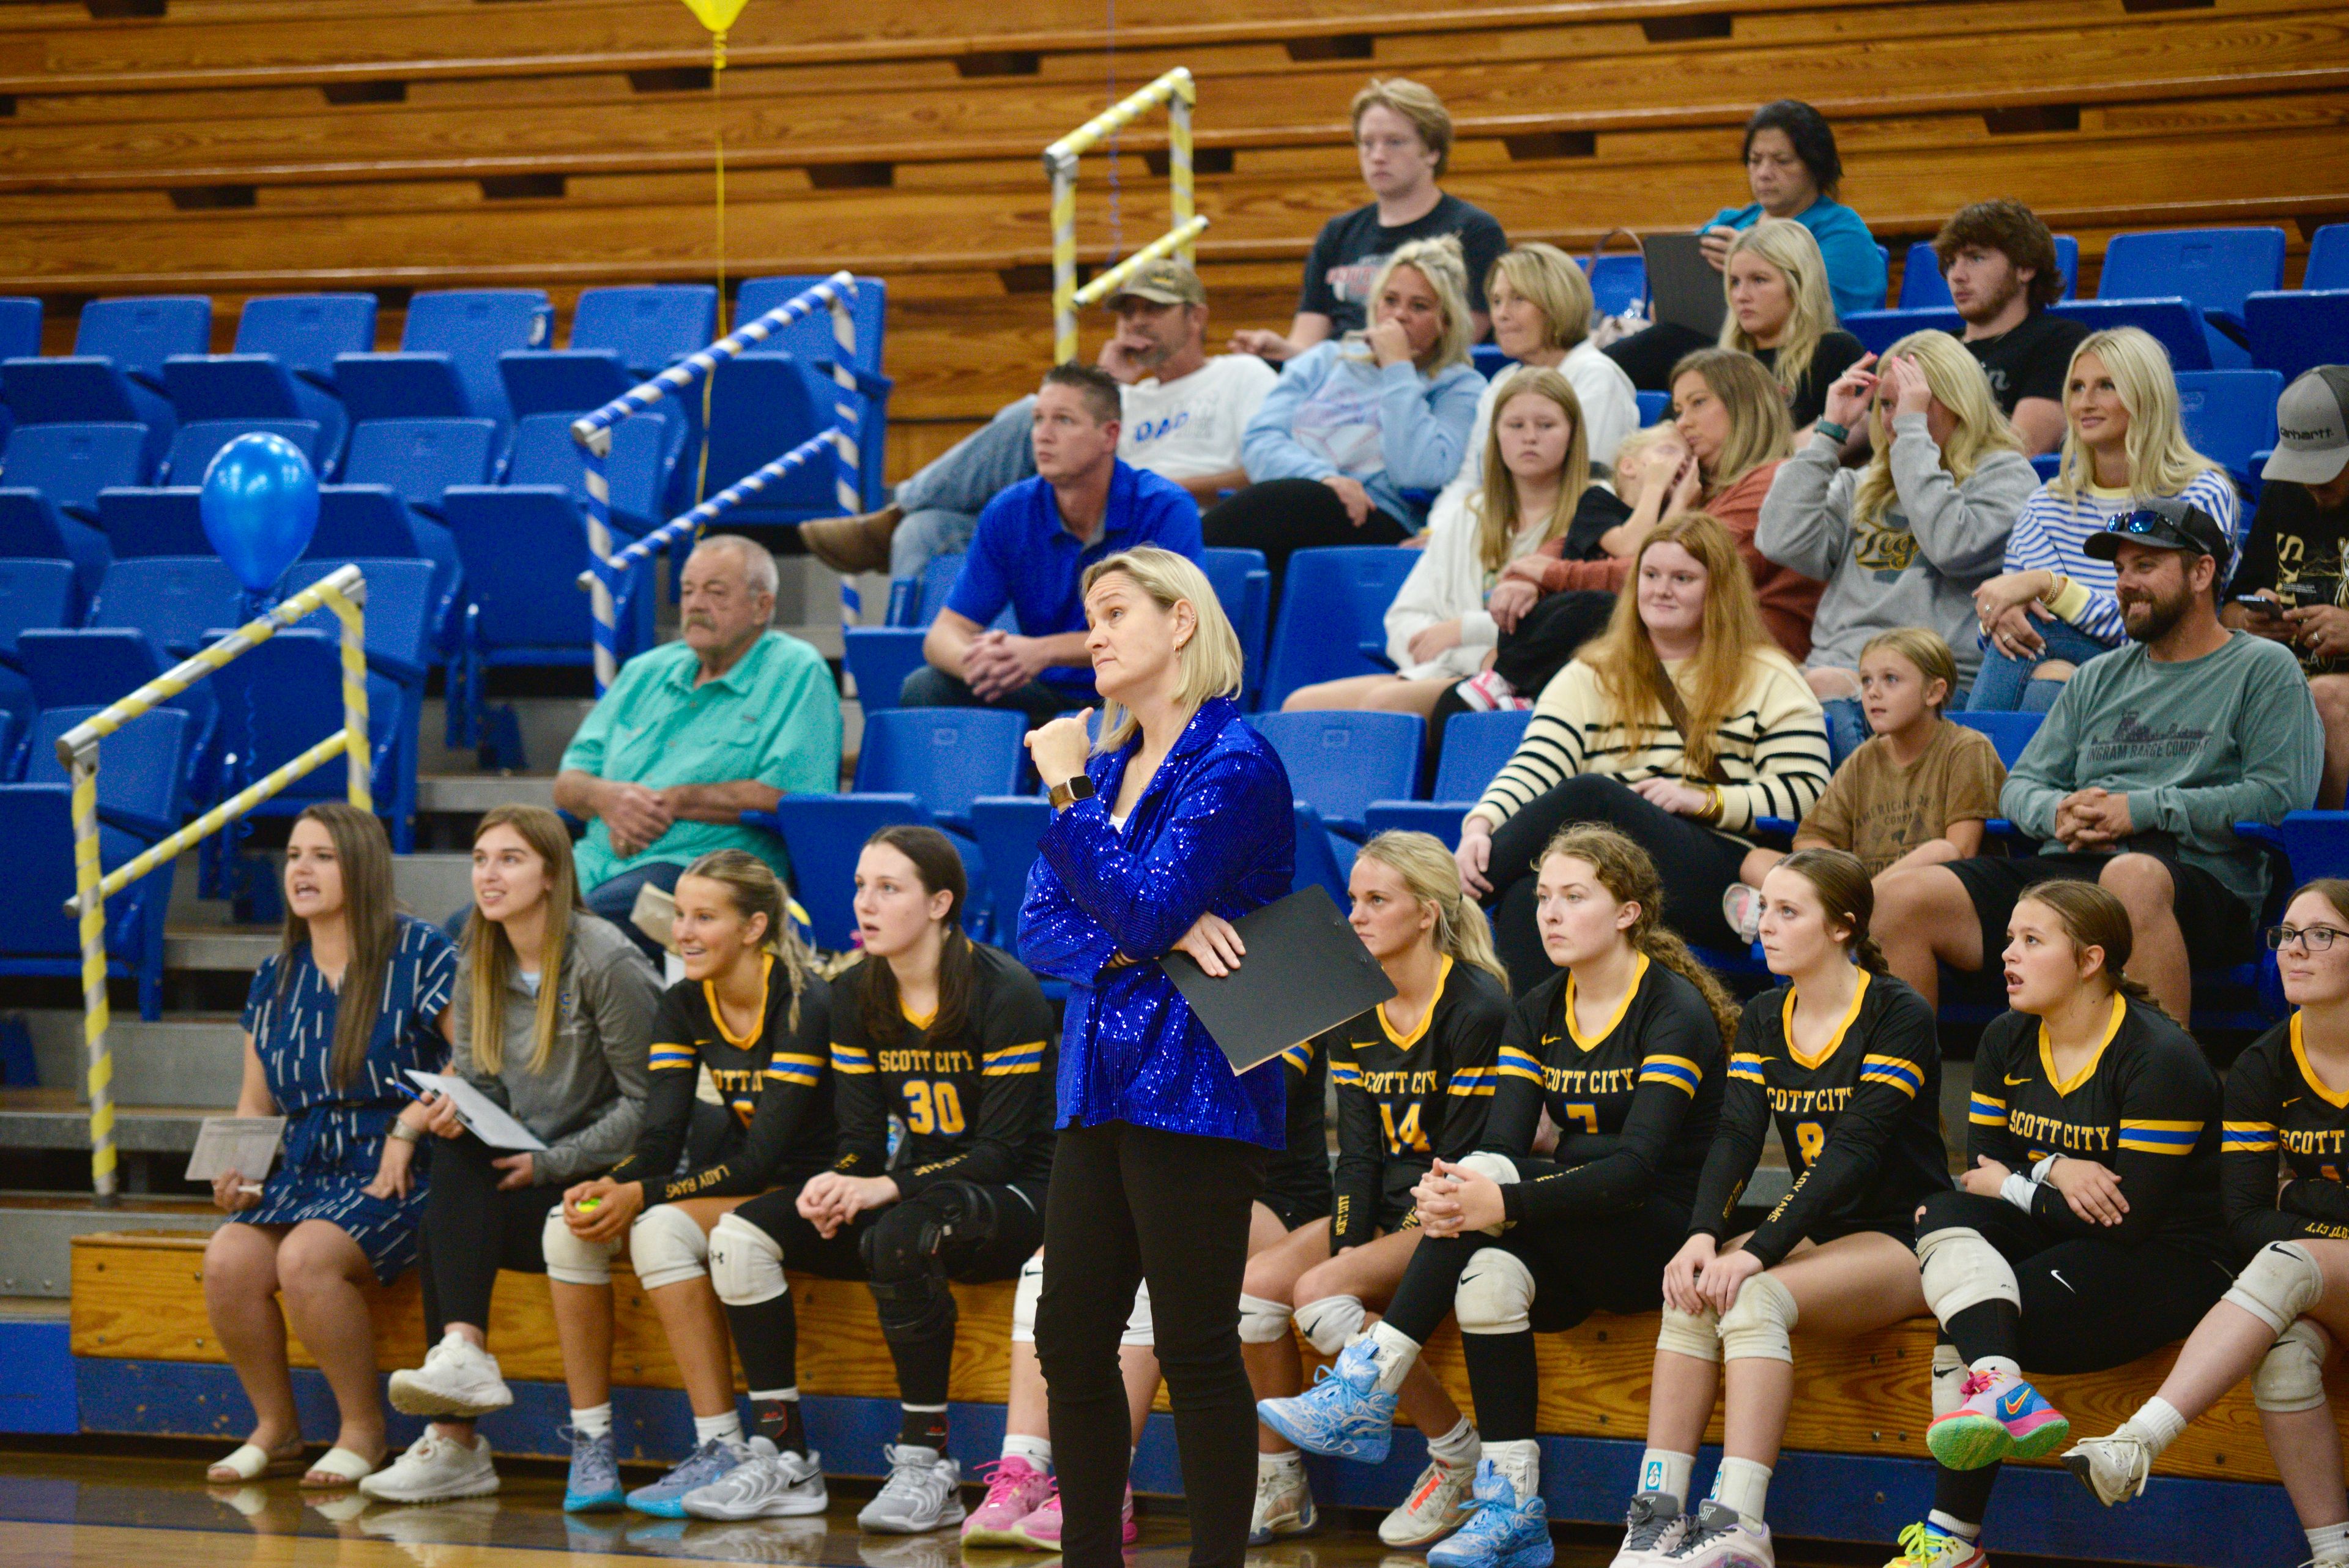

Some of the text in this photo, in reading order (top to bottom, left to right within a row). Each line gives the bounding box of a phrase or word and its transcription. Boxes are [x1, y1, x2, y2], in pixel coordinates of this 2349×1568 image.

[2087, 744, 2128, 762] INGRAM
[878, 1050, 974, 1072] SCOTT CITY
[712, 1069, 751, 1091] OTT
[1360, 1071, 1408, 1094] COTT
[1590, 1068, 1634, 1093] CITY
[902, 1079, 967, 1136] 30
[1767, 1087, 1816, 1113] COTT
[1379, 1101, 1431, 1157] 14
[1564, 1102, 1600, 1134] 7
[2009, 1109, 2110, 1151] SCOTT CITY
[2279, 1129, 2345, 1154] SCOTT
[666, 1164, 730, 1198] LADY RAMS
